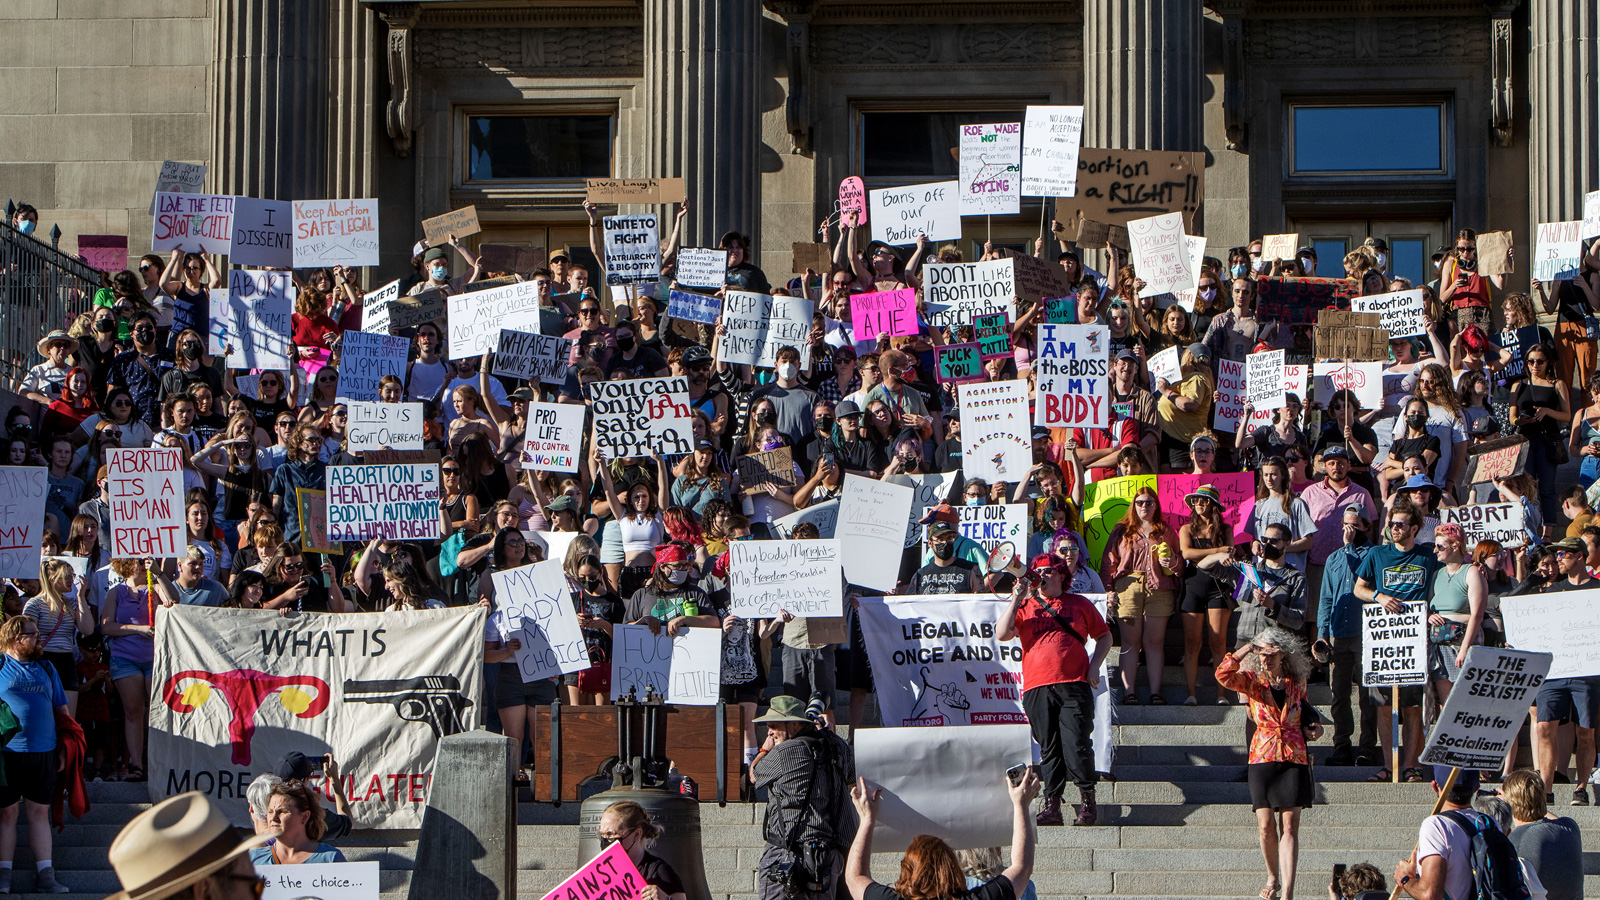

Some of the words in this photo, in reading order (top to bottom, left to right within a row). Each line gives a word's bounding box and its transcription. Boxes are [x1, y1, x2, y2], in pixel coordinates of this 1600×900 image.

[964, 126, 982, 136] ROE
[994, 124, 1020, 134] WADE
[981, 134, 998, 143] NOT
[1006, 164, 1020, 172] end
[972, 180, 1010, 194] DYING
[1085, 186, 1104, 198] a
[188, 198, 207, 212] THE
[842, 201, 852, 210] NOT
[882, 190, 914, 208] Bans
[924, 188, 946, 202] off
[295, 203, 325, 222] Keep
[901, 204, 926, 220] our
[605, 220, 638, 230] UNITE
[639, 218, 656, 230] TO
[238, 230, 292, 251] DISSENT
[614, 234, 648, 244] FIGHT
[606, 253, 658, 262] PATRIARCHY
[1547, 248, 1559, 260] IS
[616, 262, 656, 271] BIGOTRY
[930, 264, 976, 285] DON'T
[982, 266, 1012, 282] LIKE
[231, 272, 290, 300] ABORT
[386, 285, 397, 296] TO
[930, 282, 1012, 302] ABORTION?
[250, 298, 267, 310] THE
[454, 298, 471, 314] IT
[476, 288, 514, 307] SHOULD
[516, 285, 533, 297] BE
[726, 294, 756, 314] KEEP
[762, 300, 790, 318] SAFE
[894, 290, 908, 311] IS
[959, 301, 976, 310] GET
[985, 299, 992, 307] A
[1044, 300, 1060, 310] NOT
[1368, 296, 1413, 311] abortion
[981, 314, 1000, 328] NOT
[1044, 310, 1068, 320] YOUR
[1337, 314, 1362, 326] SAFE
[1402, 307, 1424, 319] then
[454, 324, 476, 340] NOT
[479, 317, 504, 332] THE
[864, 314, 874, 337] A
[878, 309, 906, 336] LIE
[365, 334, 380, 345] THE
[1042, 324, 1056, 342] I
[342, 346, 364, 356] NOT
[364, 347, 380, 357] THE
[381, 347, 406, 358] STATE
[938, 346, 972, 364] FUCK
[1041, 342, 1076, 360] AM
[1270, 350, 1283, 360] NOT
[1316, 345, 1332, 358] NOT
[944, 363, 970, 379] YOU
[1041, 358, 1069, 376] the
[1070, 358, 1107, 376] BOSS
[1220, 361, 1243, 378] MAY
[340, 376, 368, 390] MUST
[591, 382, 636, 401] you
[640, 378, 690, 395] can
[1040, 379, 1054, 392] of
[1068, 378, 1098, 394] MY
[1218, 377, 1238, 390] YOU
[966, 386, 1012, 398] AGAINST
[1218, 393, 1230, 403] TO
[594, 394, 648, 415] only
[648, 394, 692, 420] ban
[966, 396, 1025, 409] ABORTION?
[1046, 394, 1103, 425] BODY
[352, 404, 389, 420] THIS
[396, 408, 411, 422] IS
[535, 408, 556, 425] PRO
[974, 414, 1000, 423] HAVE
[596, 412, 652, 434] safe
[539, 426, 563, 441] LIFE
[526, 440, 541, 452] PRO
[542, 442, 570, 452] CONTROL
[597, 428, 693, 458] abortion
[109, 450, 183, 474] ABORTION
[331, 465, 414, 486] ABORTION
[421, 470, 434, 482] IS
[113, 478, 144, 496] IS
[161, 478, 174, 496] A
[424, 486, 438, 498] and
[113, 498, 171, 522] HUMAN
[330, 503, 378, 523] BODILY
[383, 500, 440, 520] AUTONOMY
[984, 506, 1006, 521] OUR
[1446, 504, 1514, 524] ABORT
[330, 524, 341, 541] IS
[345, 524, 355, 541] A
[360, 522, 397, 541] HUMAN
[400, 520, 439, 540] RIGHT
[1010, 524, 1020, 536] or
[116, 526, 180, 556] RIGHT
[504, 564, 538, 604] MY
[794, 588, 806, 600] by
[807, 587, 832, 599] the
[506, 588, 563, 630] BODY
[1364, 606, 1382, 618] WE
[1368, 618, 1387, 629] GO
[1389, 616, 1420, 627] BACK
[524, 619, 551, 649] MY
[902, 622, 964, 640] LEGAL
[1370, 630, 1390, 641] WE
[1391, 628, 1418, 639] WILL
[261, 629, 354, 658] WHAT
[362, 628, 387, 658] IS
[623, 627, 692, 664] FUCK
[522, 640, 589, 677] CHOICE
[892, 646, 944, 666] ONCE
[951, 645, 994, 662] AND
[1372, 646, 1414, 659] FIGHT
[1372, 658, 1415, 672] BACK!
[1496, 656, 1526, 672] THE
[984, 672, 1000, 685] WE
[1464, 667, 1527, 687] SYSTEM
[1526, 674, 1544, 688] IS
[980, 686, 992, 700] WE
[994, 688, 1017, 701] WILL
[1468, 682, 1527, 701] SEXIST!
[1453, 712, 1490, 729] Fight
[1492, 715, 1512, 730] for
[1436, 733, 1508, 752] Socialism!
[278, 875, 302, 888] the
